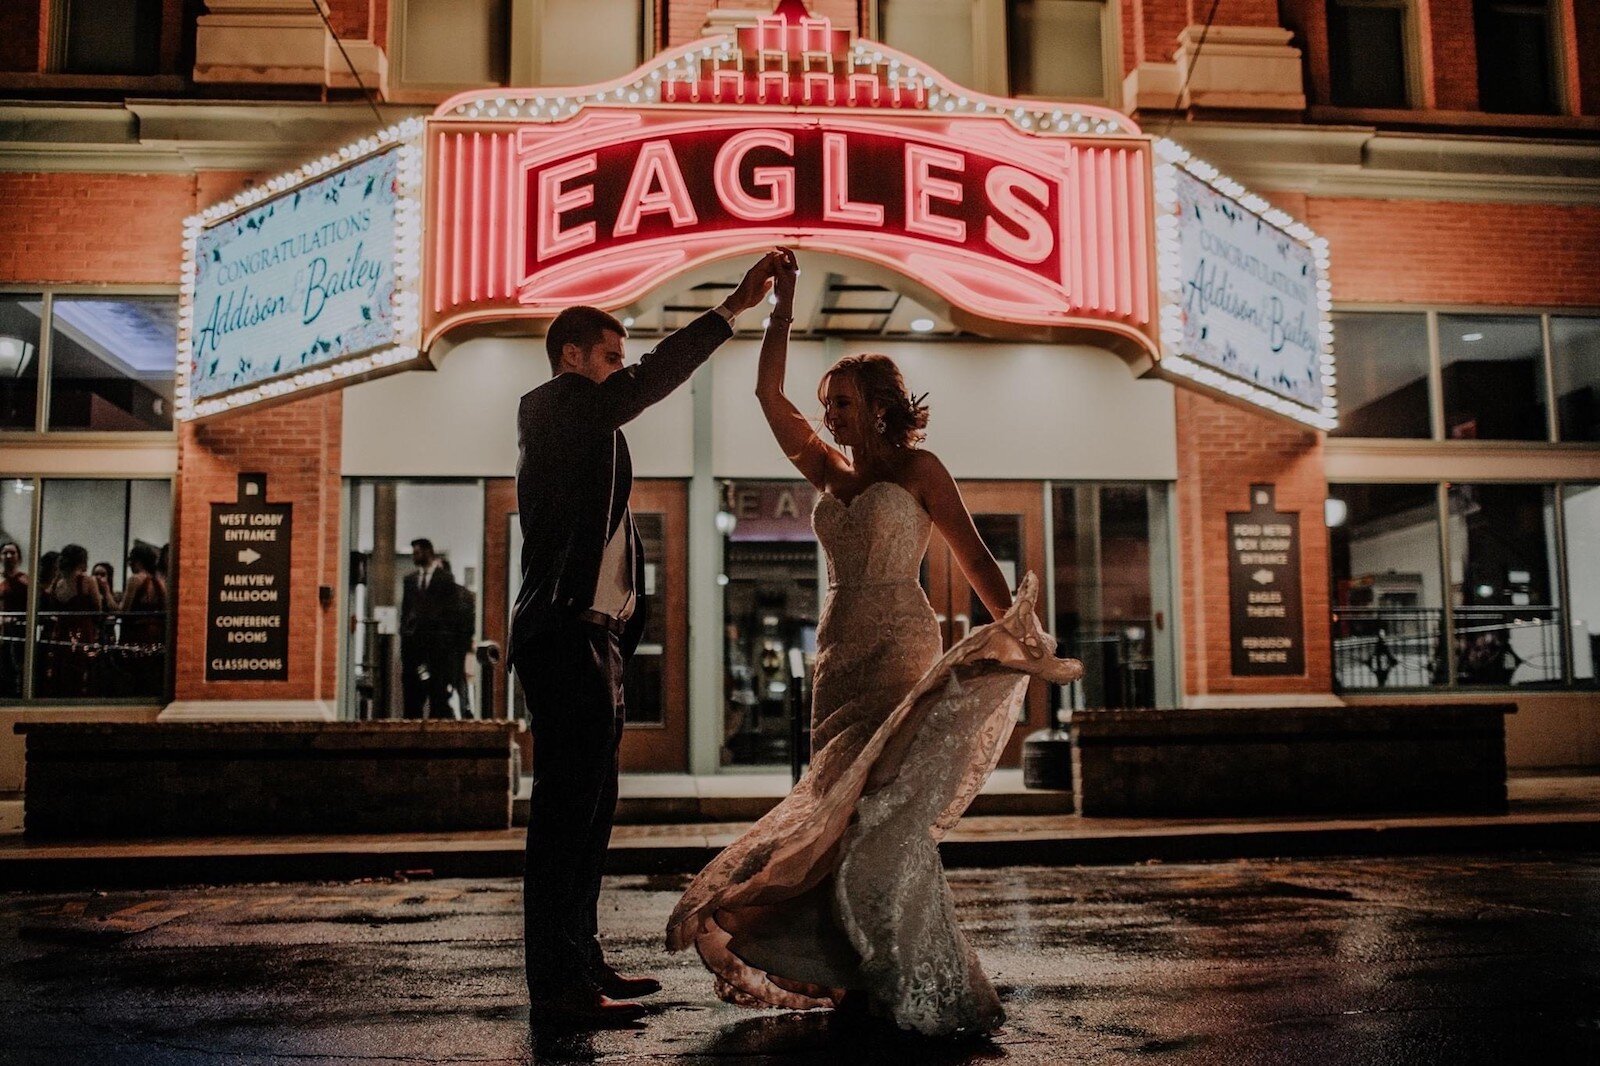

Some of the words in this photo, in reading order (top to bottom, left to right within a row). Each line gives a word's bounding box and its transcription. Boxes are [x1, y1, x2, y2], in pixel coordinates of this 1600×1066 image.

[536, 129, 1055, 263] EAGLES
[216, 208, 372, 286] CONGRATULATIONS
[1187, 258, 1259, 326] Addison
[198, 286, 286, 358] Addison
[302, 241, 382, 325] Bailey
[219, 514, 247, 526] WEST
[250, 514, 284, 526] LOBBY
[224, 529, 277, 542] ENTRANCE
[224, 574, 275, 586] PARKVIEW
[220, 590, 278, 602] BALLROOM
[216, 616, 281, 628] CONFERENCE
[227, 631, 268, 644] ROOMS
[211, 658, 283, 670] CLASSROOMS
